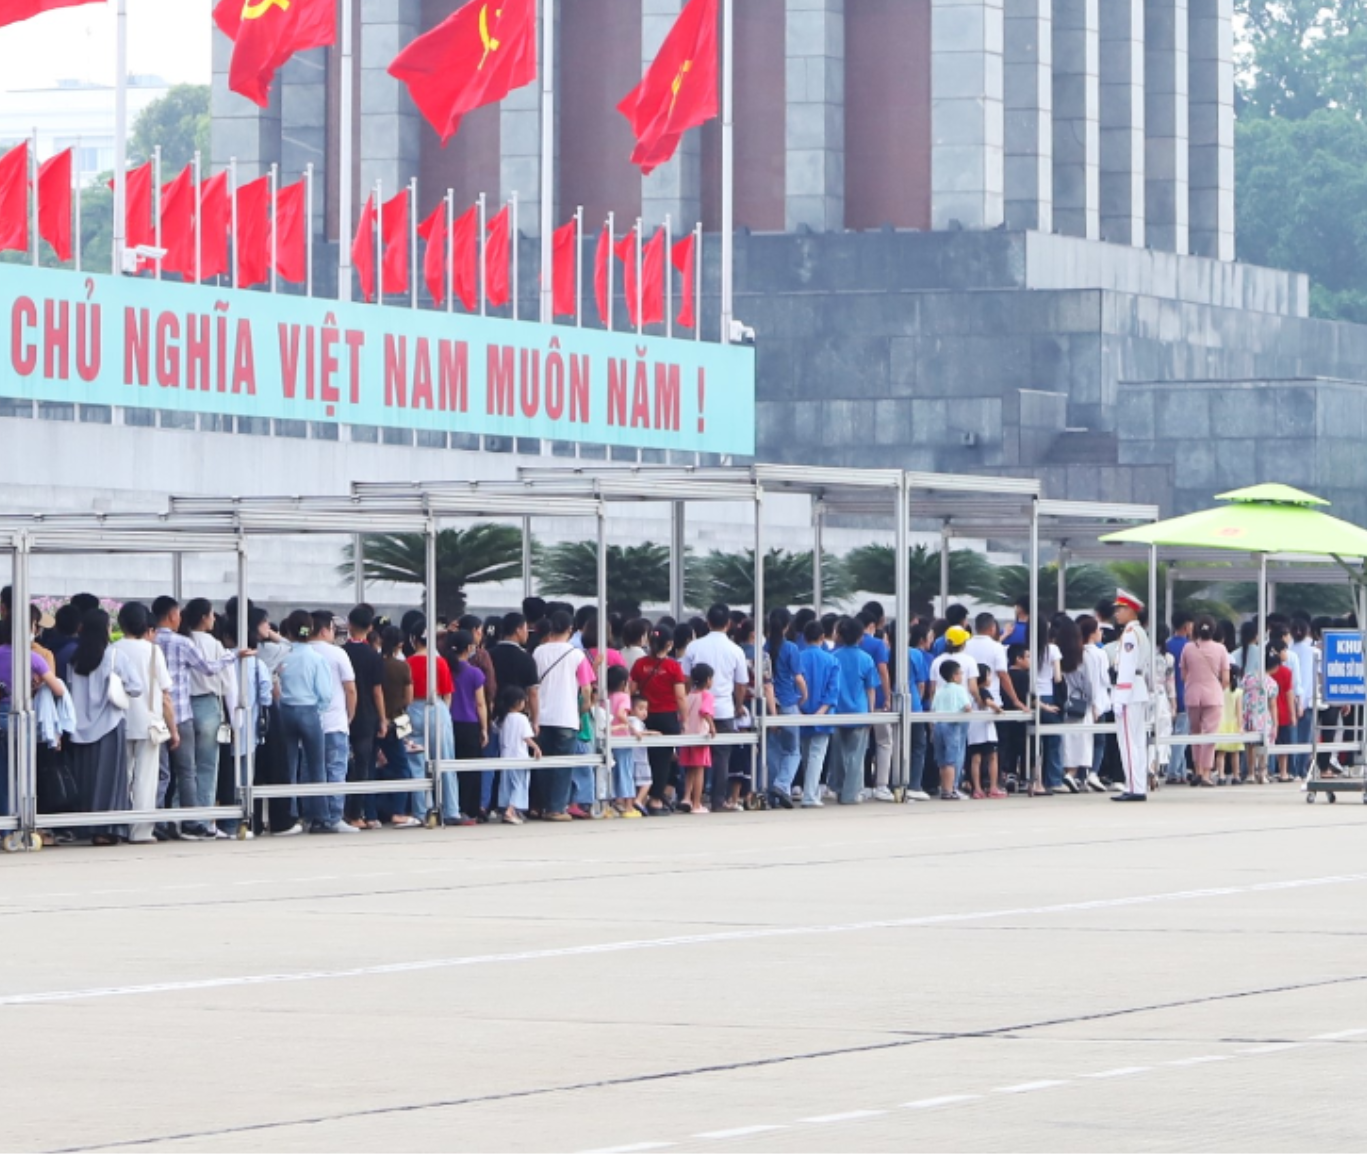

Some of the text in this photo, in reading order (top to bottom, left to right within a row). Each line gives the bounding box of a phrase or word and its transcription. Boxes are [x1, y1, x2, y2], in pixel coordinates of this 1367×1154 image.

[11, 277, 102, 382] CHỦ
[123, 299, 256, 396] NGHĨA
[277, 311, 365, 417] VIỆT
[383, 334, 469, 414] NAM
[486, 335, 590, 424] MUÔN
[607, 344, 681, 432] NĂM
[1336, 639, 1363, 654] KHU
